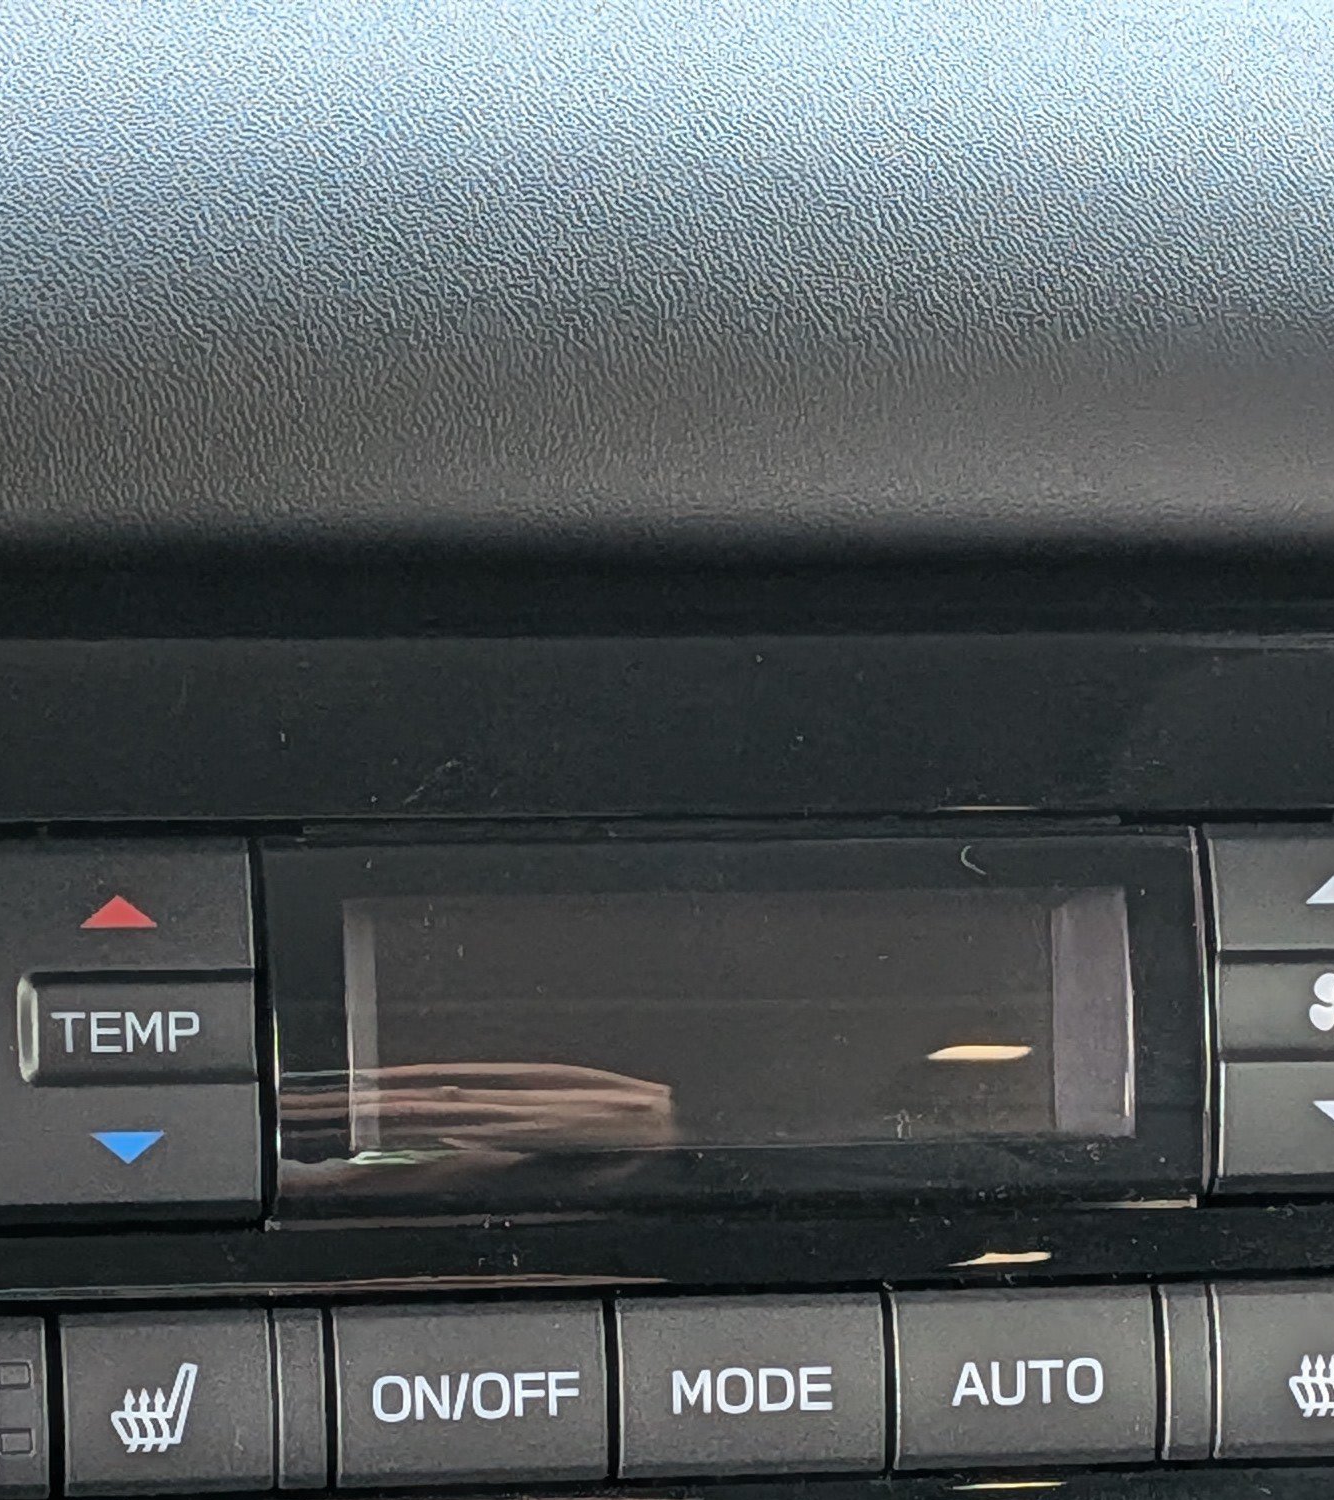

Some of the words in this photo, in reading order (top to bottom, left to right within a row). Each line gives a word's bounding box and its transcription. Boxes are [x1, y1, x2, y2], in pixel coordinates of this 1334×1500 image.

[51, 1011, 201, 1054] TEMP
[372, 1371, 581, 1424] ON/OFF
[672, 1366, 834, 1416] MODE
[951, 1357, 1105, 1408] AUTO
